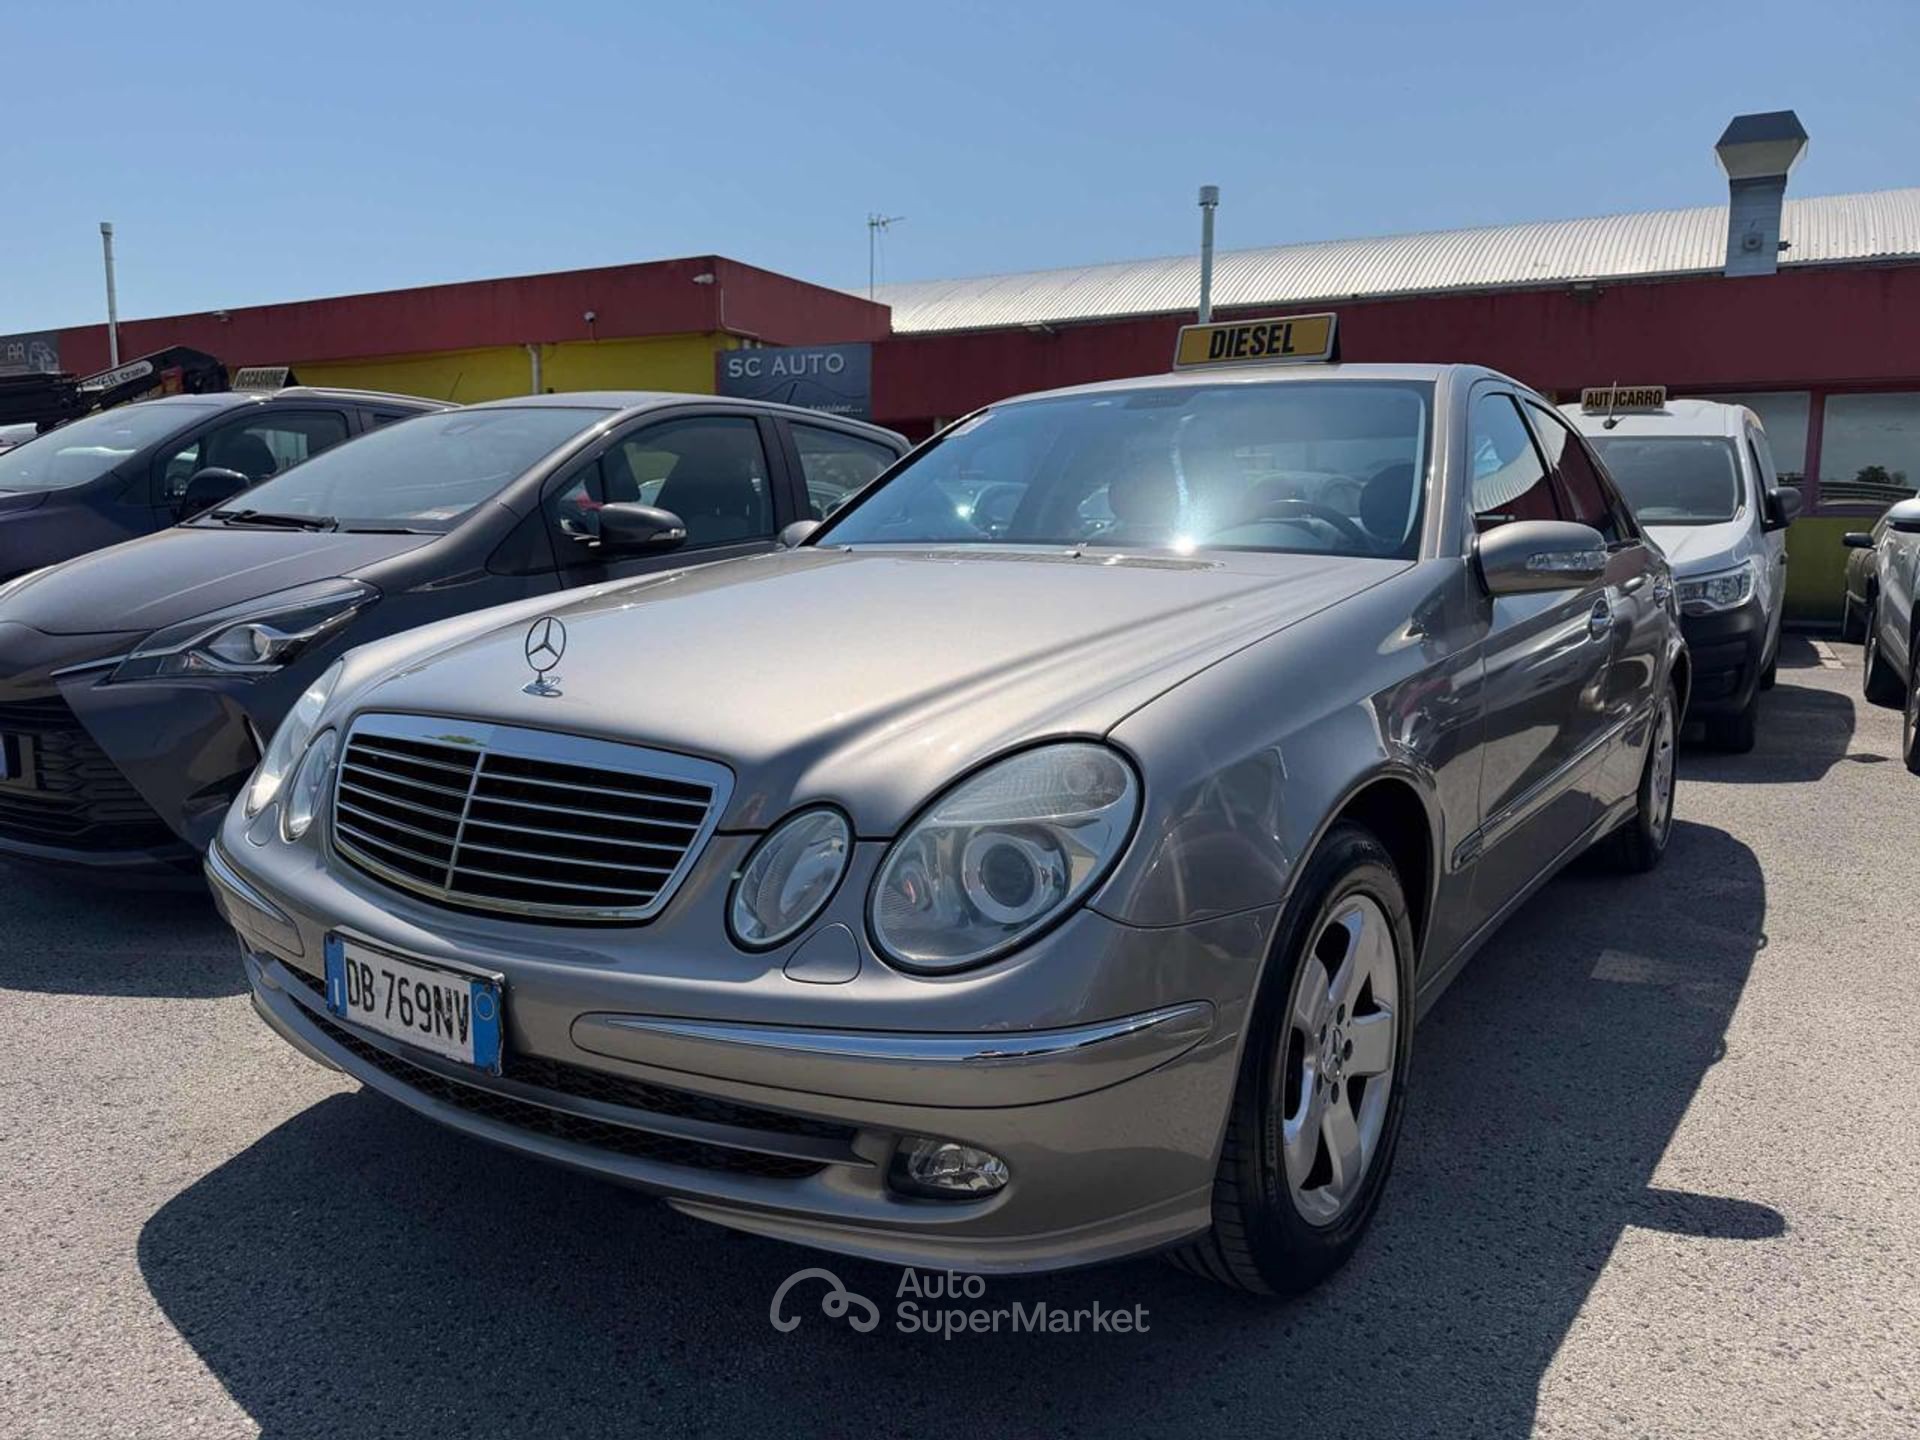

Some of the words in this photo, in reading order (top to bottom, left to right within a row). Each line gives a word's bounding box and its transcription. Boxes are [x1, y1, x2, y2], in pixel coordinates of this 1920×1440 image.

[1209, 323, 1295, 360] DIESEL
[728, 358, 761, 378] SC
[771, 353, 845, 376] AUTO
[1585, 390, 1663, 409] AUTOCARRO
